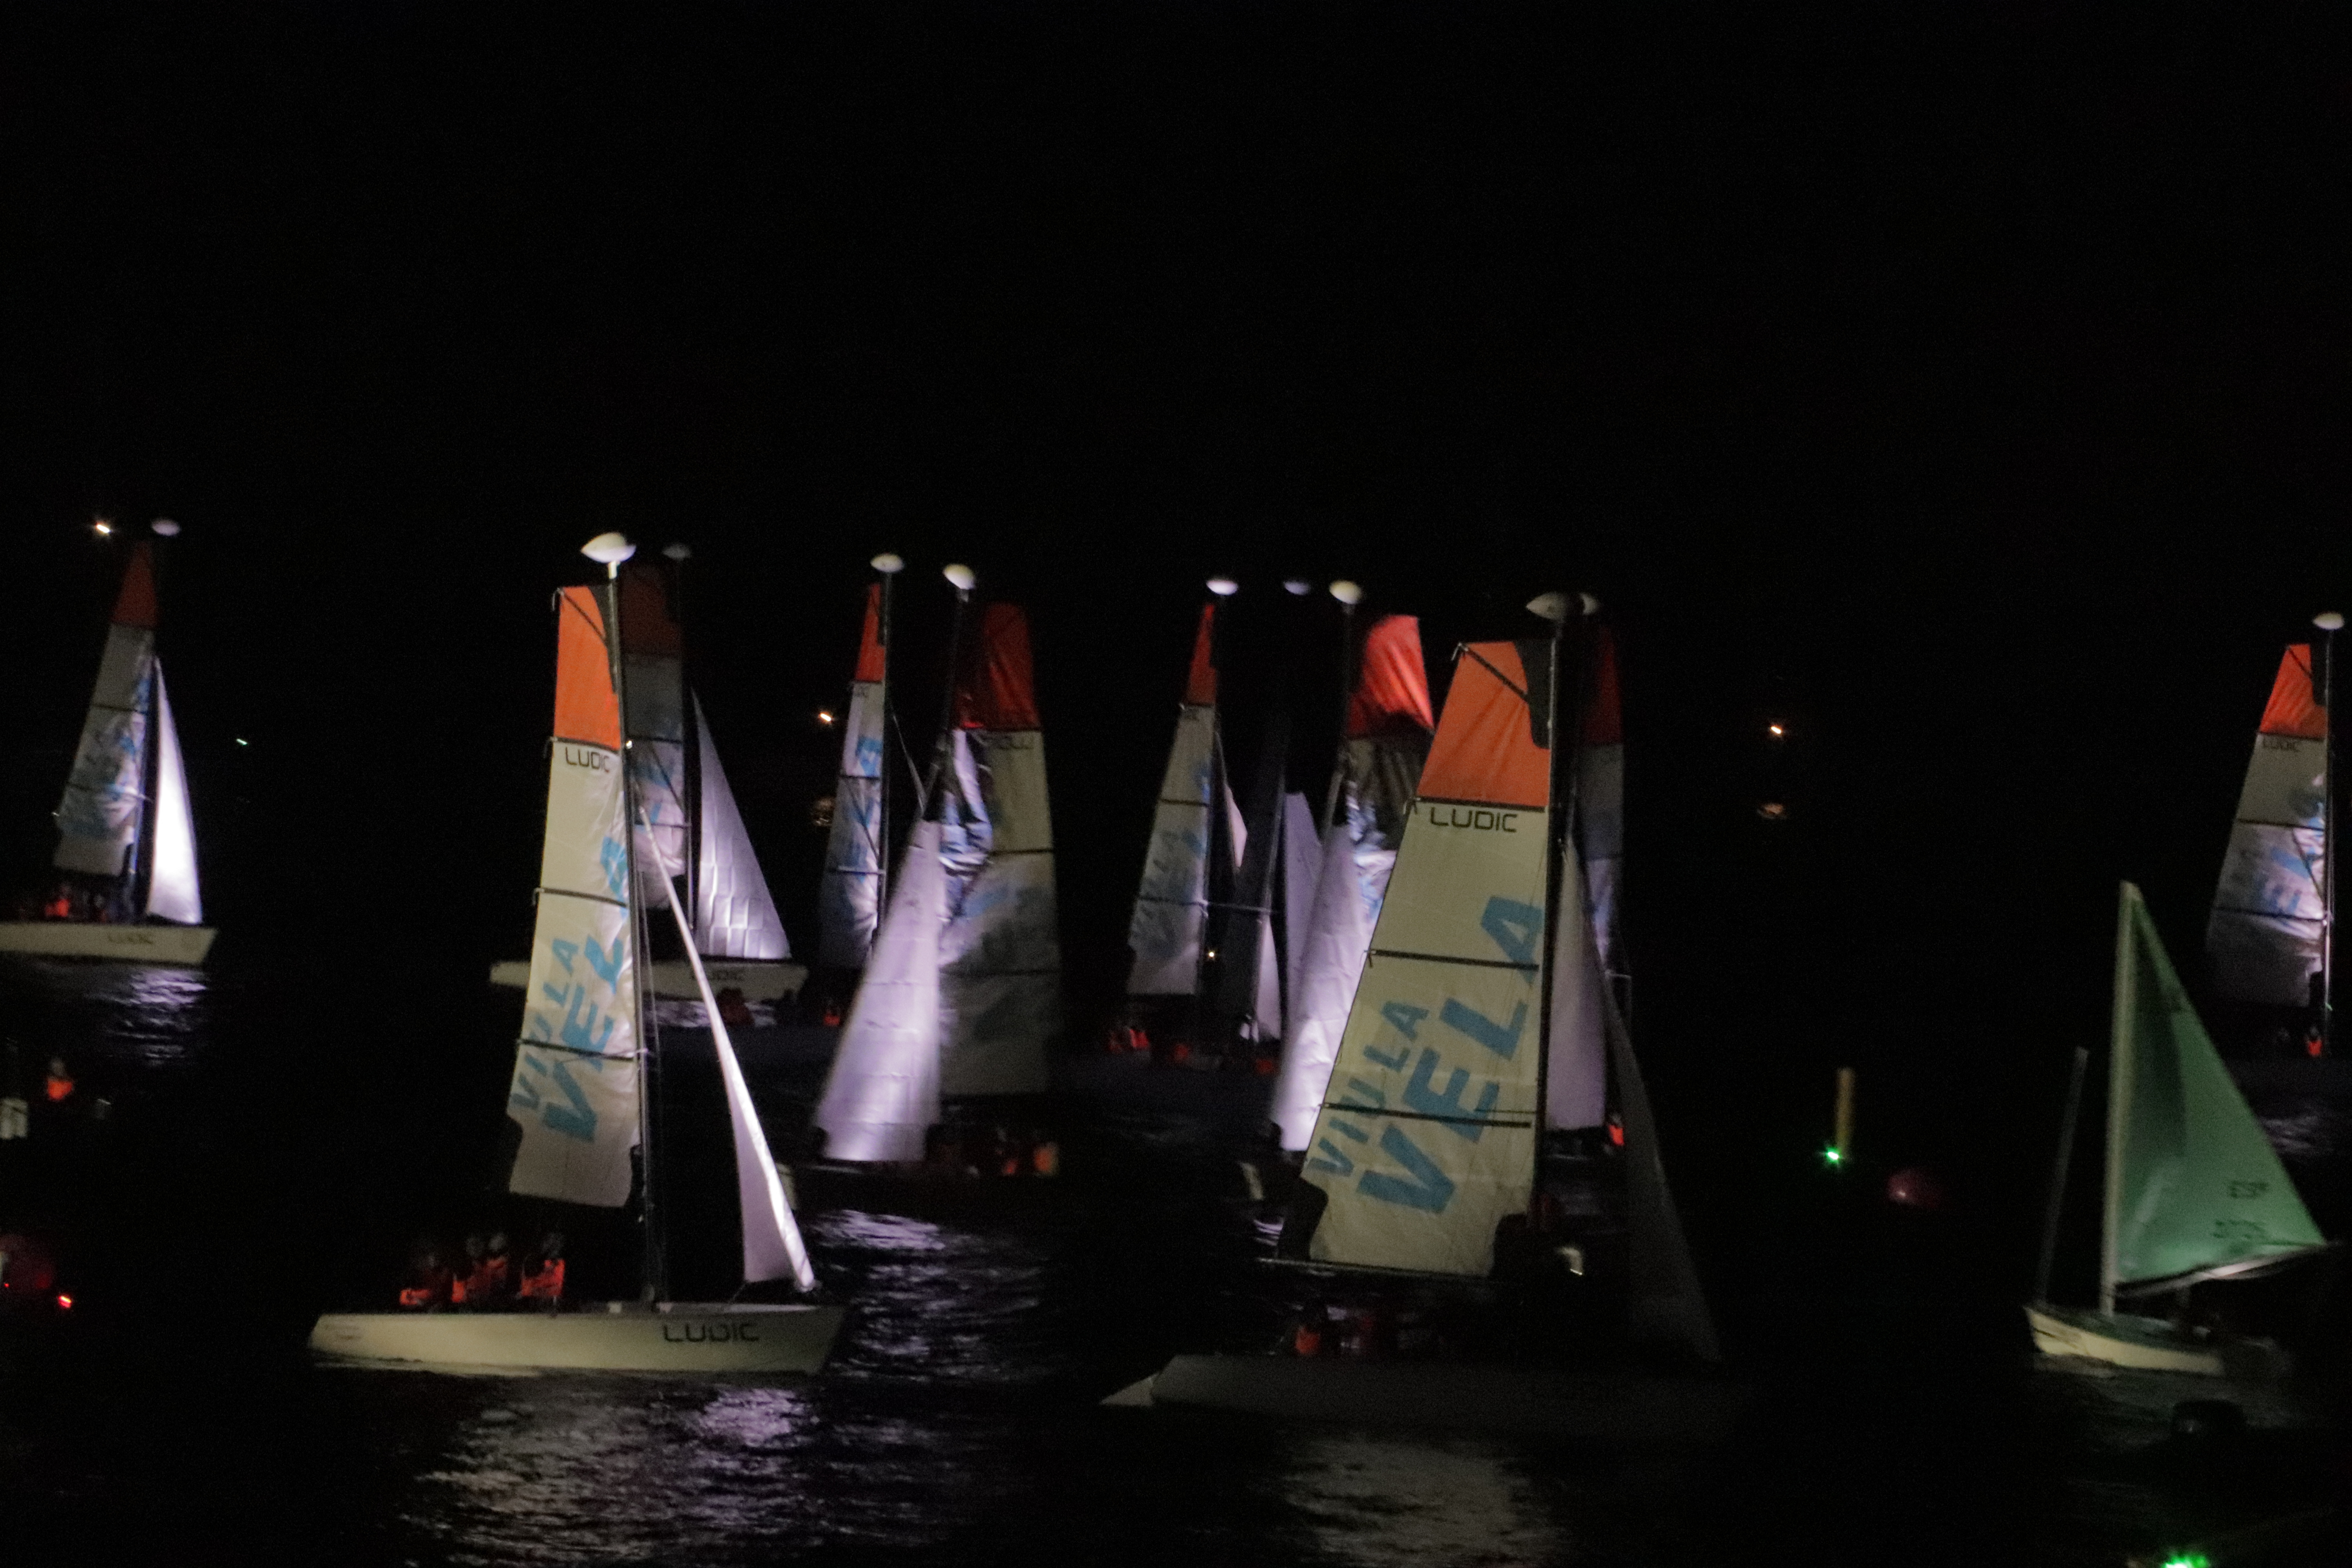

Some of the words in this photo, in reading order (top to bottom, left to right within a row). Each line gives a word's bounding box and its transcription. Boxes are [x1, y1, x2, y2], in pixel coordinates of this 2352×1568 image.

[564, 747, 611, 773] LUDIC
[1429, 807, 1517, 834] LUDIC
[1356, 895, 1543, 1215] VELA
[1305, 1000, 1430, 1177] VILLA
[662, 1322, 760, 1342] LUDIC
